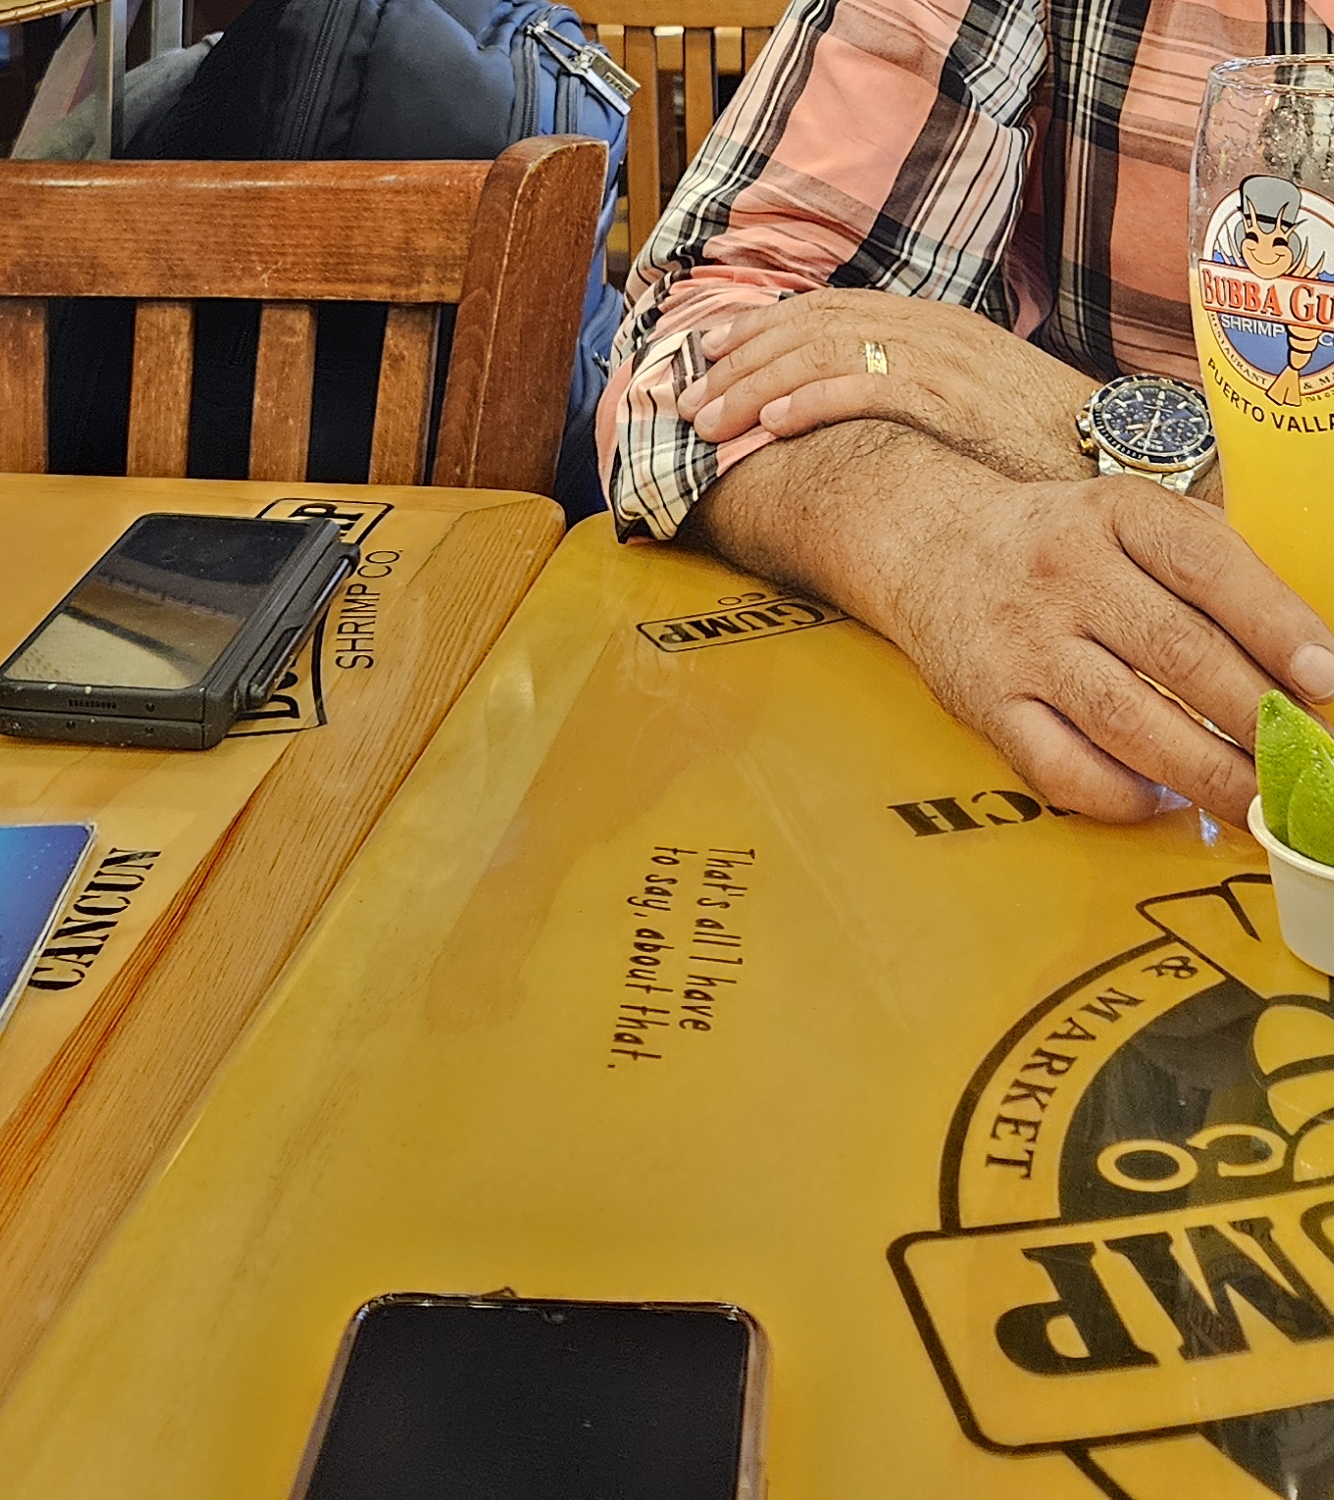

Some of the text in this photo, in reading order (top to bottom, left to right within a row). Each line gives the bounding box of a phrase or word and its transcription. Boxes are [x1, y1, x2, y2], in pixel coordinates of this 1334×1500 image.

[1202, 268, 1283, 317] BUBBA
[1210, 313, 1268, 386] RESTAURANT
[1220, 315, 1286, 339] SHRIMP
[1207, 357, 1265, 423] PUERTO
[336, 549, 404, 669] SHRIMP CO.
[659, 602, 825, 644] GUMP
[650, 846, 699, 866] to
[696, 848, 756, 909] That's
[27, 847, 162, 992] CANCUN
[691, 918, 742, 948] all
[624, 927, 675, 995] about
[678, 974, 738, 1032] have
[607, 1004, 671, 1069] that.
[983, 954, 1199, 1181] & MARKET
[1095, 1123, 1290, 1193] CO
